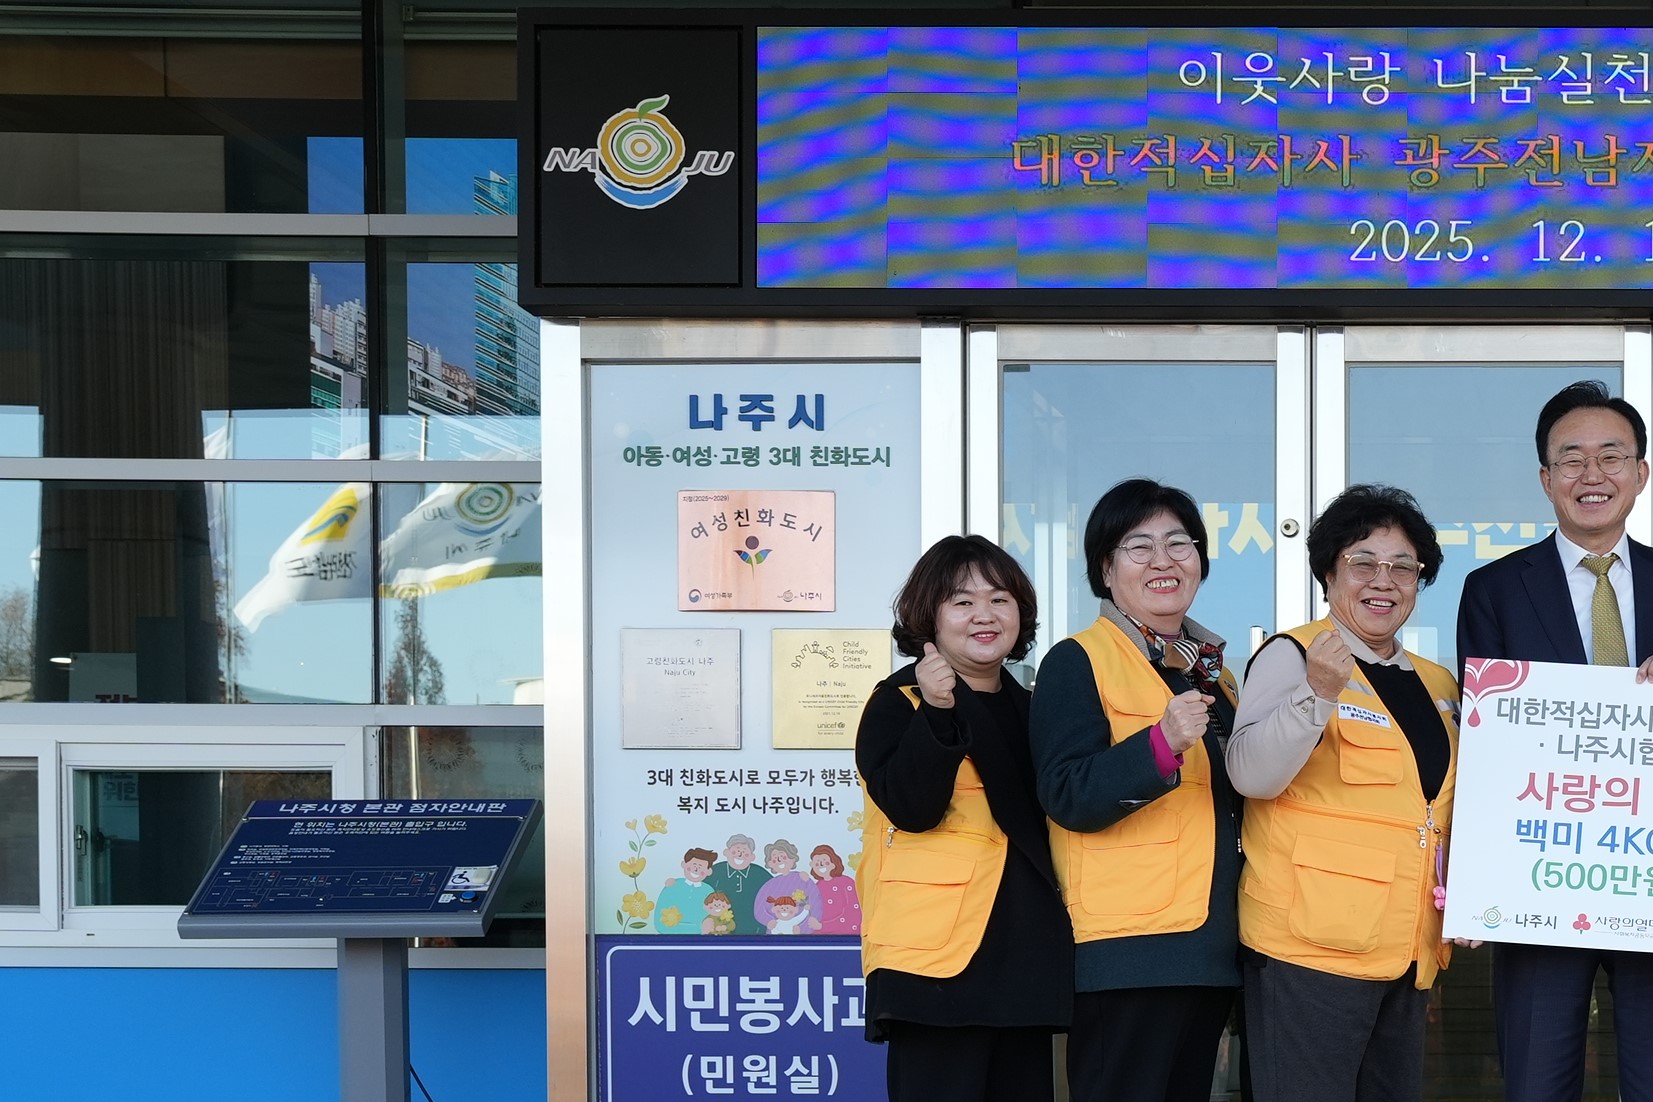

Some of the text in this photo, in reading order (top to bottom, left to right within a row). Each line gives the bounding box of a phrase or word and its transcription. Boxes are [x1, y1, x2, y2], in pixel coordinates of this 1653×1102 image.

[1178, 50, 1400, 107] 이웃사랑
[1010, 134, 1357, 190] 대한적십자사
[1349, 218, 1490, 266] 2025.
[1532, 218, 1602, 266] 12.
[689, 393, 825, 431] 나주시
[769, 446, 801, 468] 3대
[810, 446, 892, 468] 친화도시
[690, 508, 823, 542] 여성친화도시
[842, 648, 869, 656] Friendly
[682, 669, 696, 677] City
[647, 768, 674, 788] 3대
[679, 768, 762, 788] 친화도시로
[766, 768, 816, 788] 모두가
[1516, 771, 1641, 816] 사랑의
[278, 803, 357, 814] 나주시청
[408, 802, 507, 814] 점자안내판
[677, 795, 840, 816] 복지 도시 나주입니다.
[1515, 819, 1583, 854] 백미
[1515, 913, 1558, 929] 나주시
[682, 1054, 839, 1096] (민원실)
